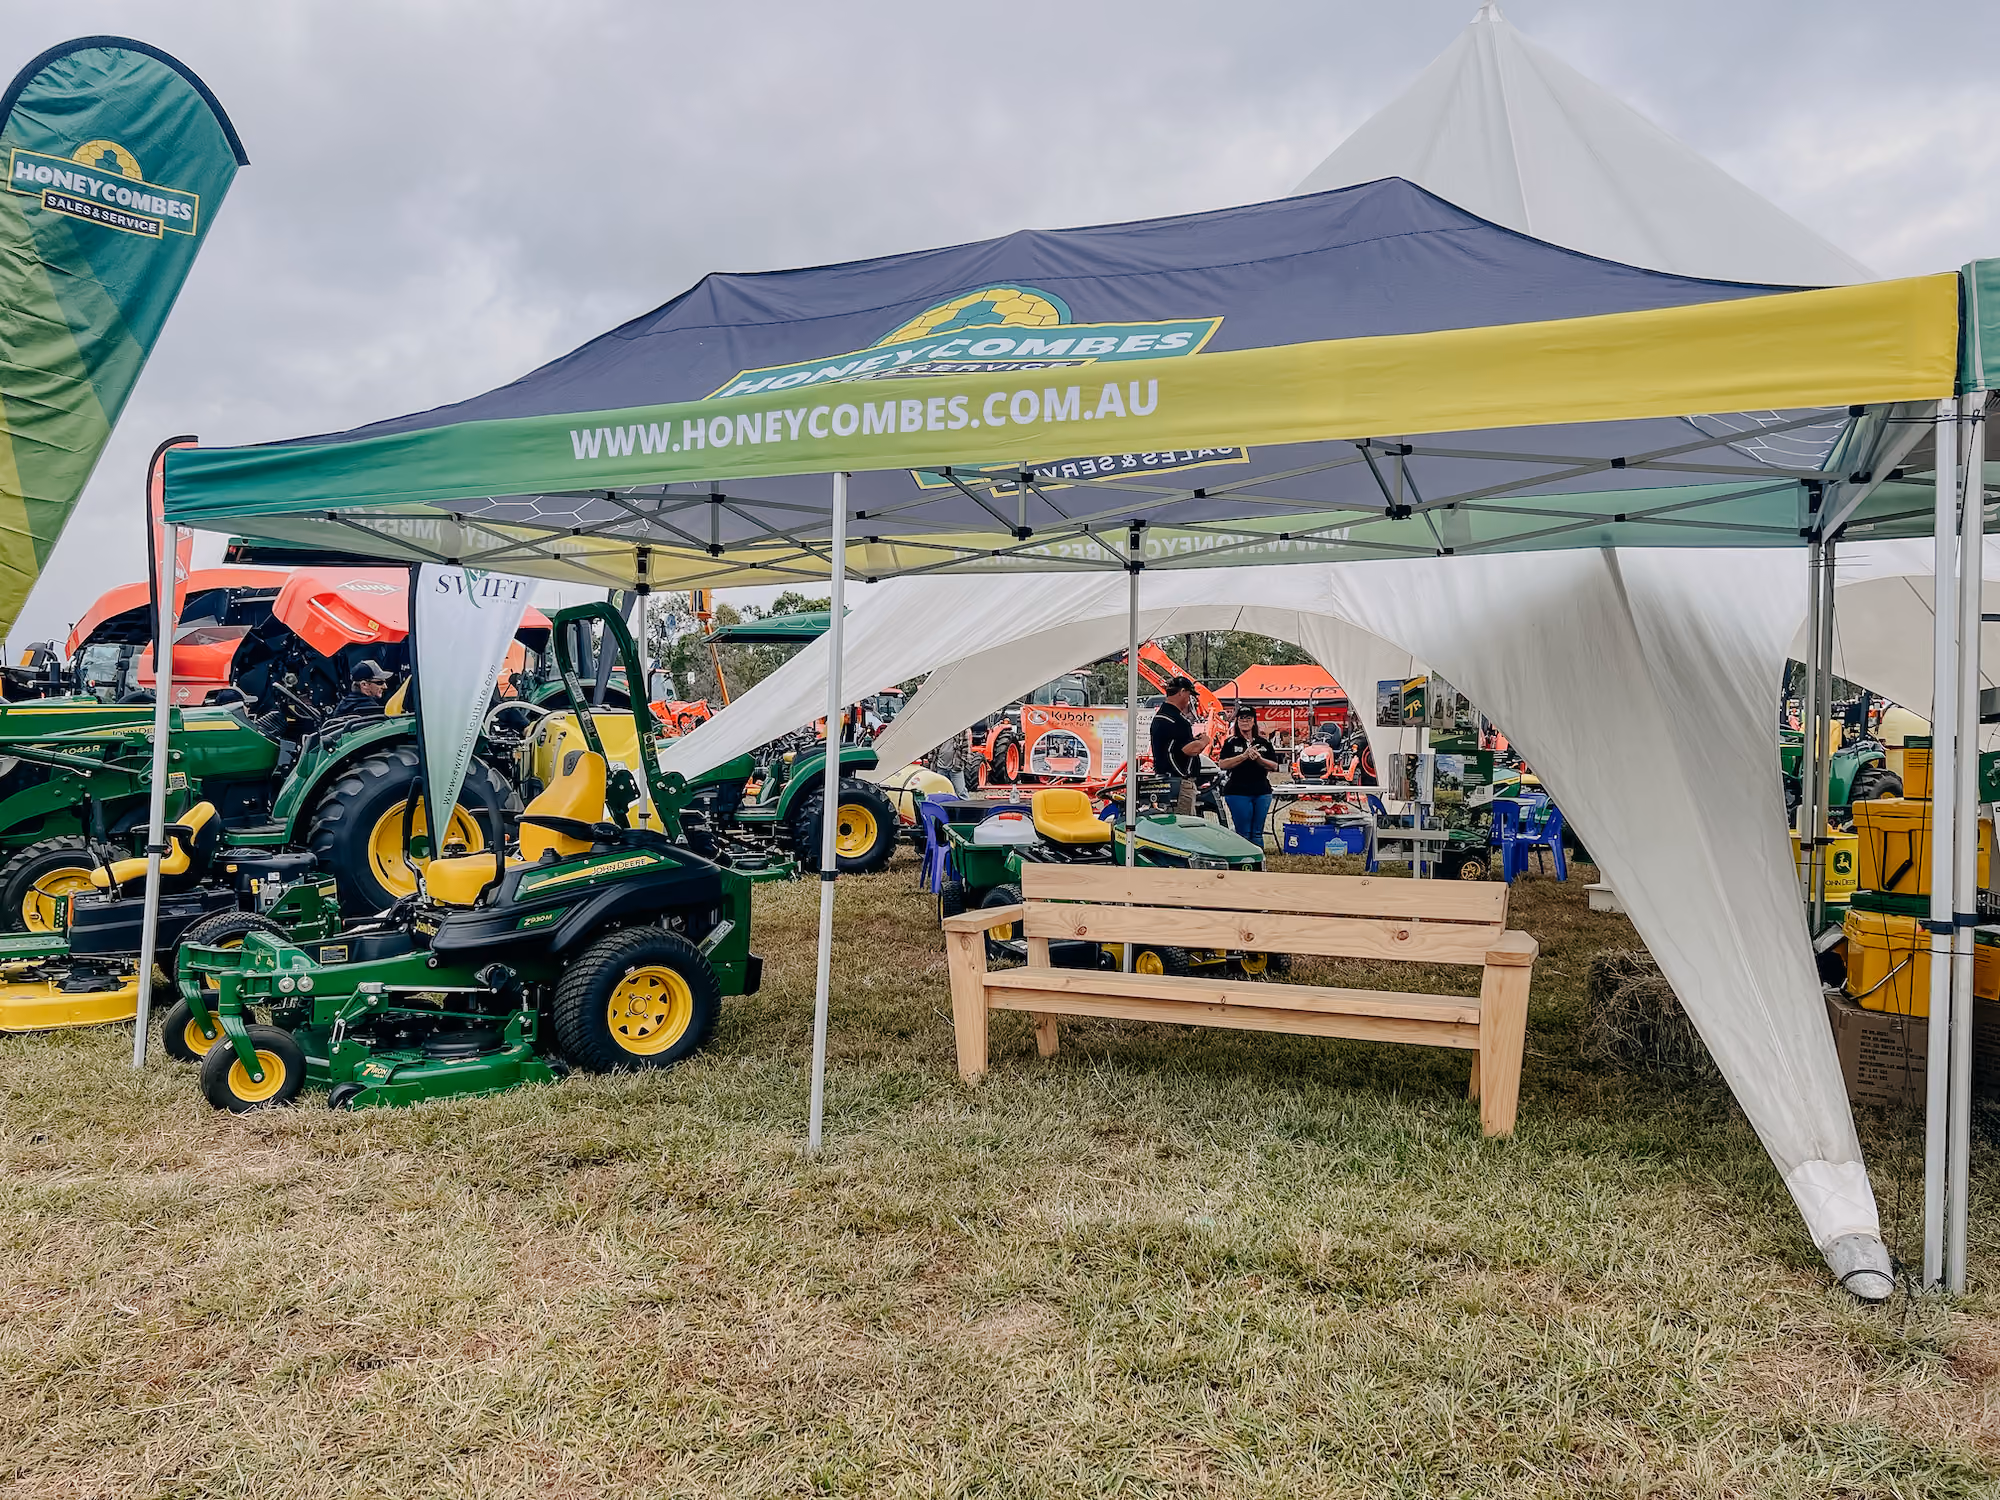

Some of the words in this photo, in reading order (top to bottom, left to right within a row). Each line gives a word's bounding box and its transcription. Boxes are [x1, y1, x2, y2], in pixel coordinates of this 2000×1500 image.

[16, 161, 193, 221] HONEYCOMBES
[719, 331, 1194, 398] HONEYCOMBES
[569, 378, 1160, 460] WWW.HONEYCOMBES.COM.AU
[435, 573, 527, 600] SWIFT
[1051, 711, 1095, 722] Kubota
[61, 744, 101, 754] 4044R
[592, 863, 616, 875] JOHN
[616, 858, 647, 871] DEERE
[1824, 879, 1842, 887] OHN
